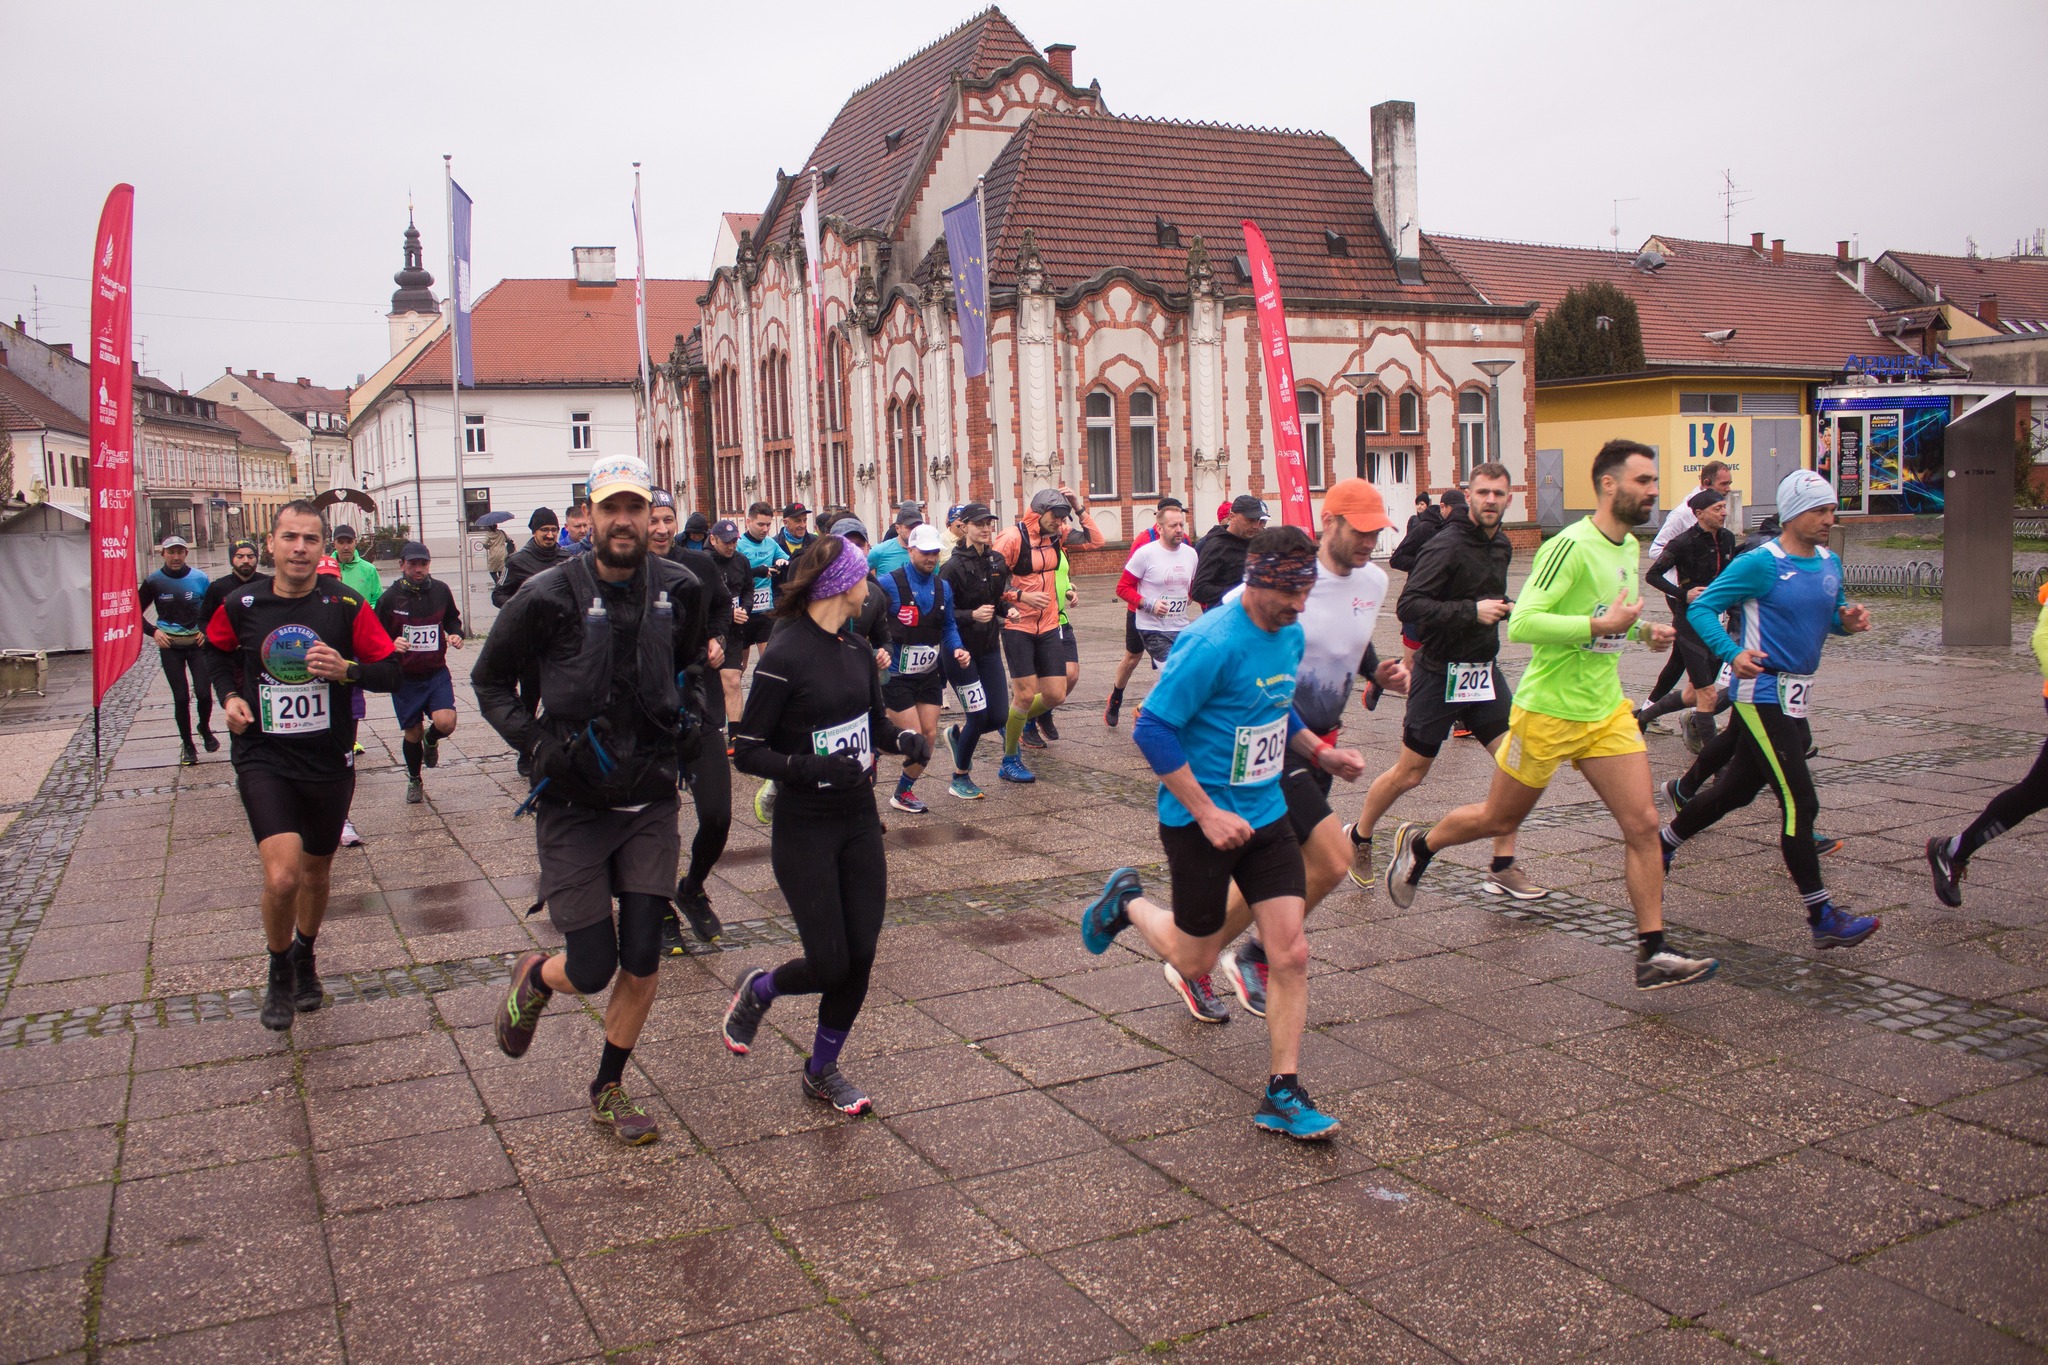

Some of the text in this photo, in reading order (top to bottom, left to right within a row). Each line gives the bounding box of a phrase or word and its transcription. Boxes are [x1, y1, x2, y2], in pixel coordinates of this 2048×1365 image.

[1843, 353, 1949, 371] ADMIRAL
[754, 592, 769, 604] 222
[1169, 601, 1187, 612] 227
[279, 626, 315, 639] BACKYARD
[412, 630, 437, 644] 219
[912, 651, 935, 666] 169
[1450, 664, 1457, 675] 6
[1459, 669, 1490, 690] 202
[262, 687, 271, 700] 6
[278, 693, 326, 719] 201
[816, 732, 827, 749] 6
[1239, 729, 1250, 746] 6
